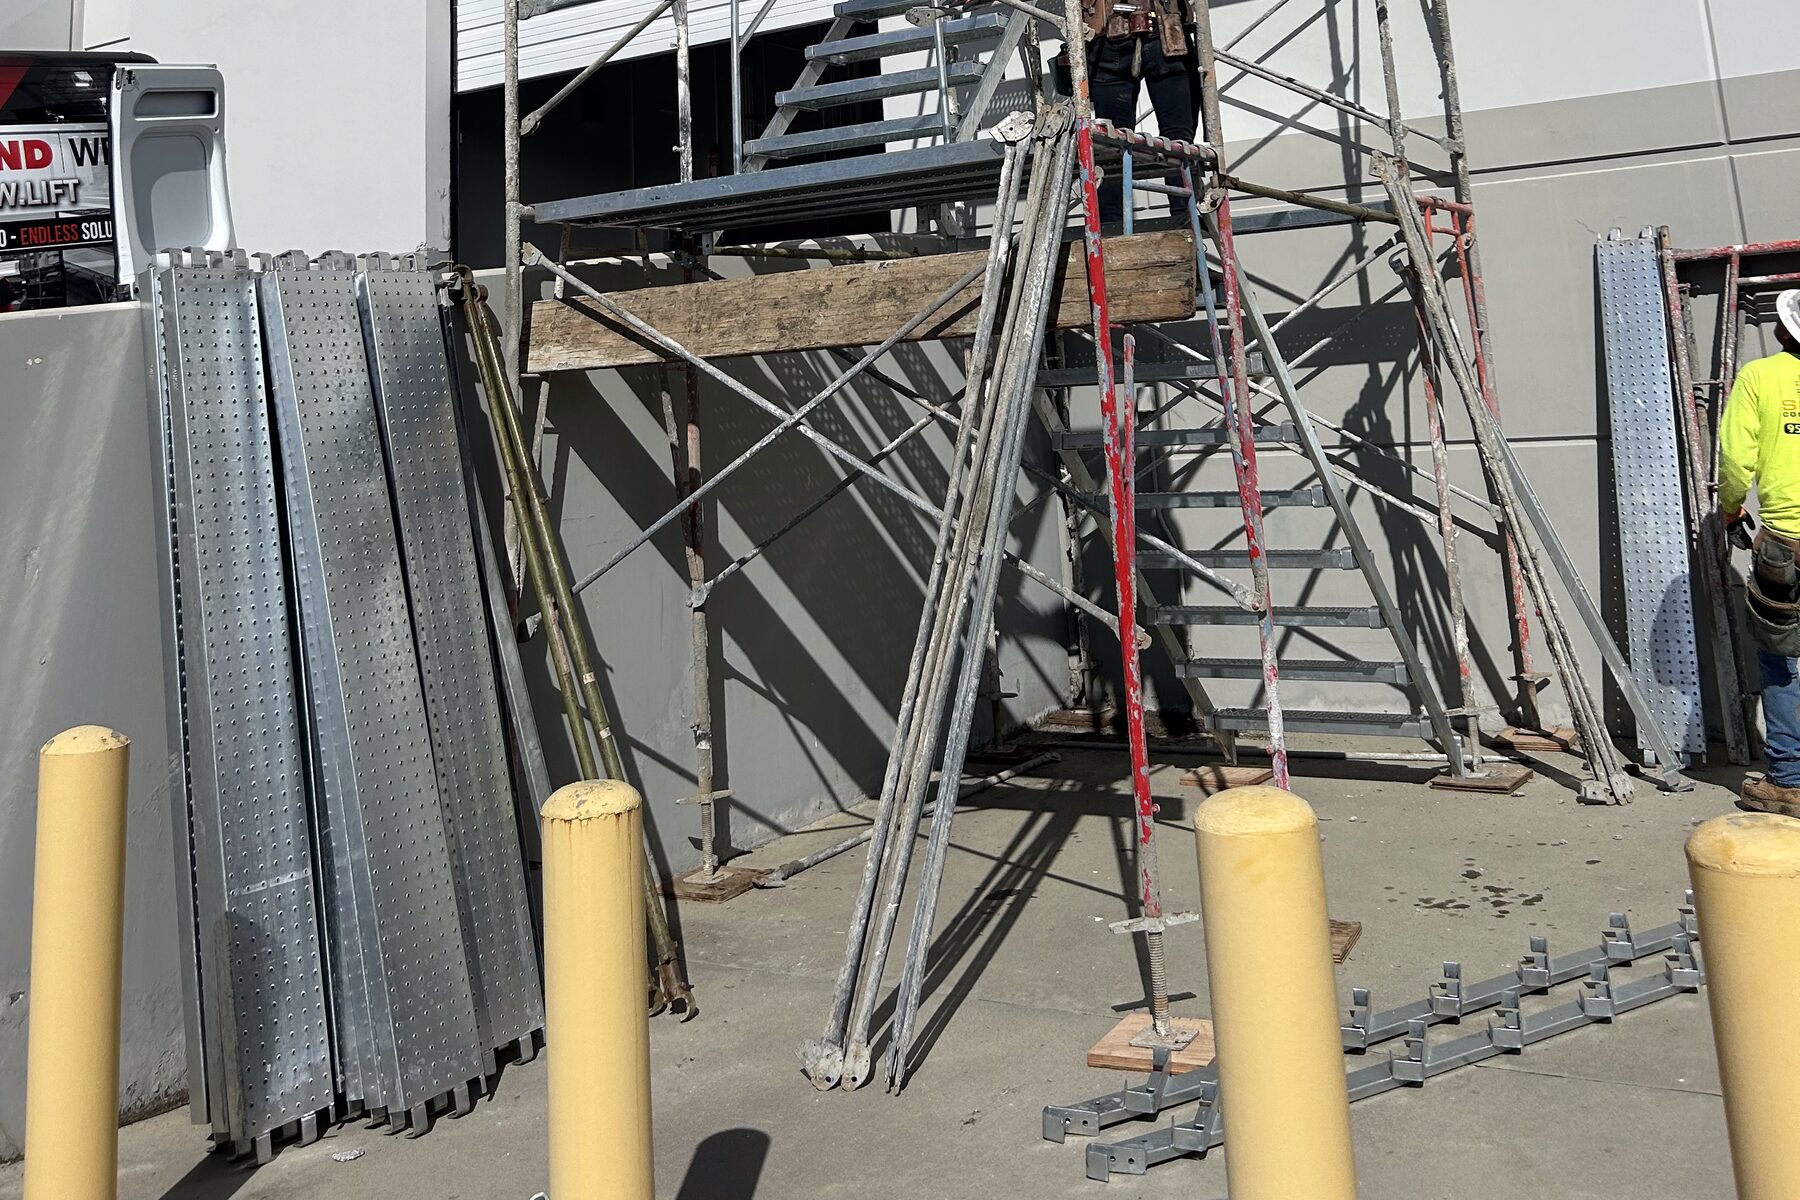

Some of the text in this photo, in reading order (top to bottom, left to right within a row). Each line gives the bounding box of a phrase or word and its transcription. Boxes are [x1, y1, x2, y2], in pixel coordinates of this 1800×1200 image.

[20, 224, 79, 246] ENDLESS
[81, 220, 112, 240] SOLU
[1782, 399, 1800, 411] S
